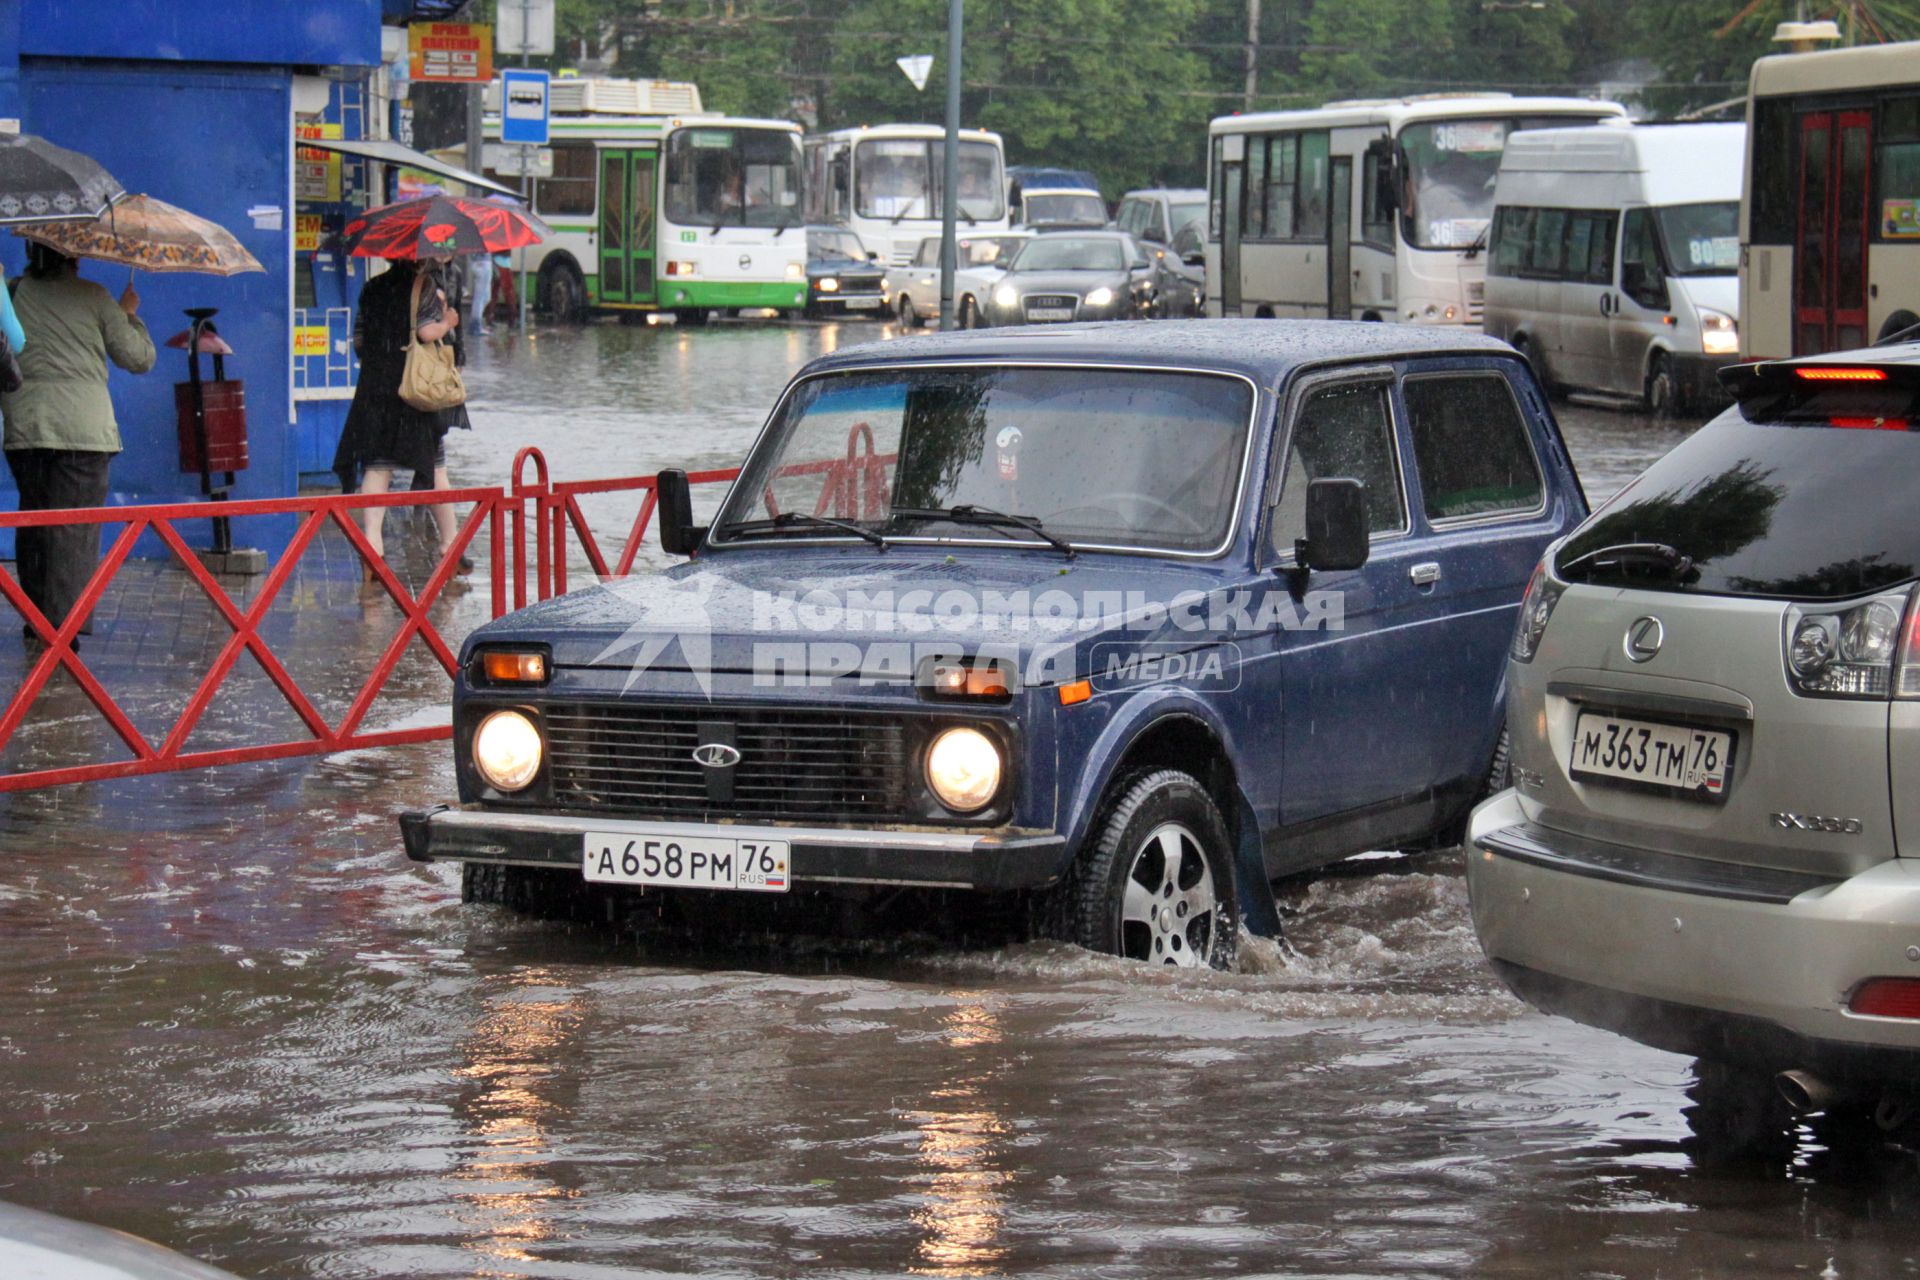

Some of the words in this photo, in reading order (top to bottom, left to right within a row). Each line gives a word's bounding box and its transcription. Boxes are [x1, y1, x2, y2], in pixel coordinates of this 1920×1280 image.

[1435, 125, 1456, 151] 36
[1429, 220, 1451, 246] 36
[1689, 239, 1714, 265] 80
[1692, 734, 1718, 772] 76
[1687, 770, 1707, 785] RUS
[741, 844, 775, 873] 76
[739, 873, 764, 885] RUS
